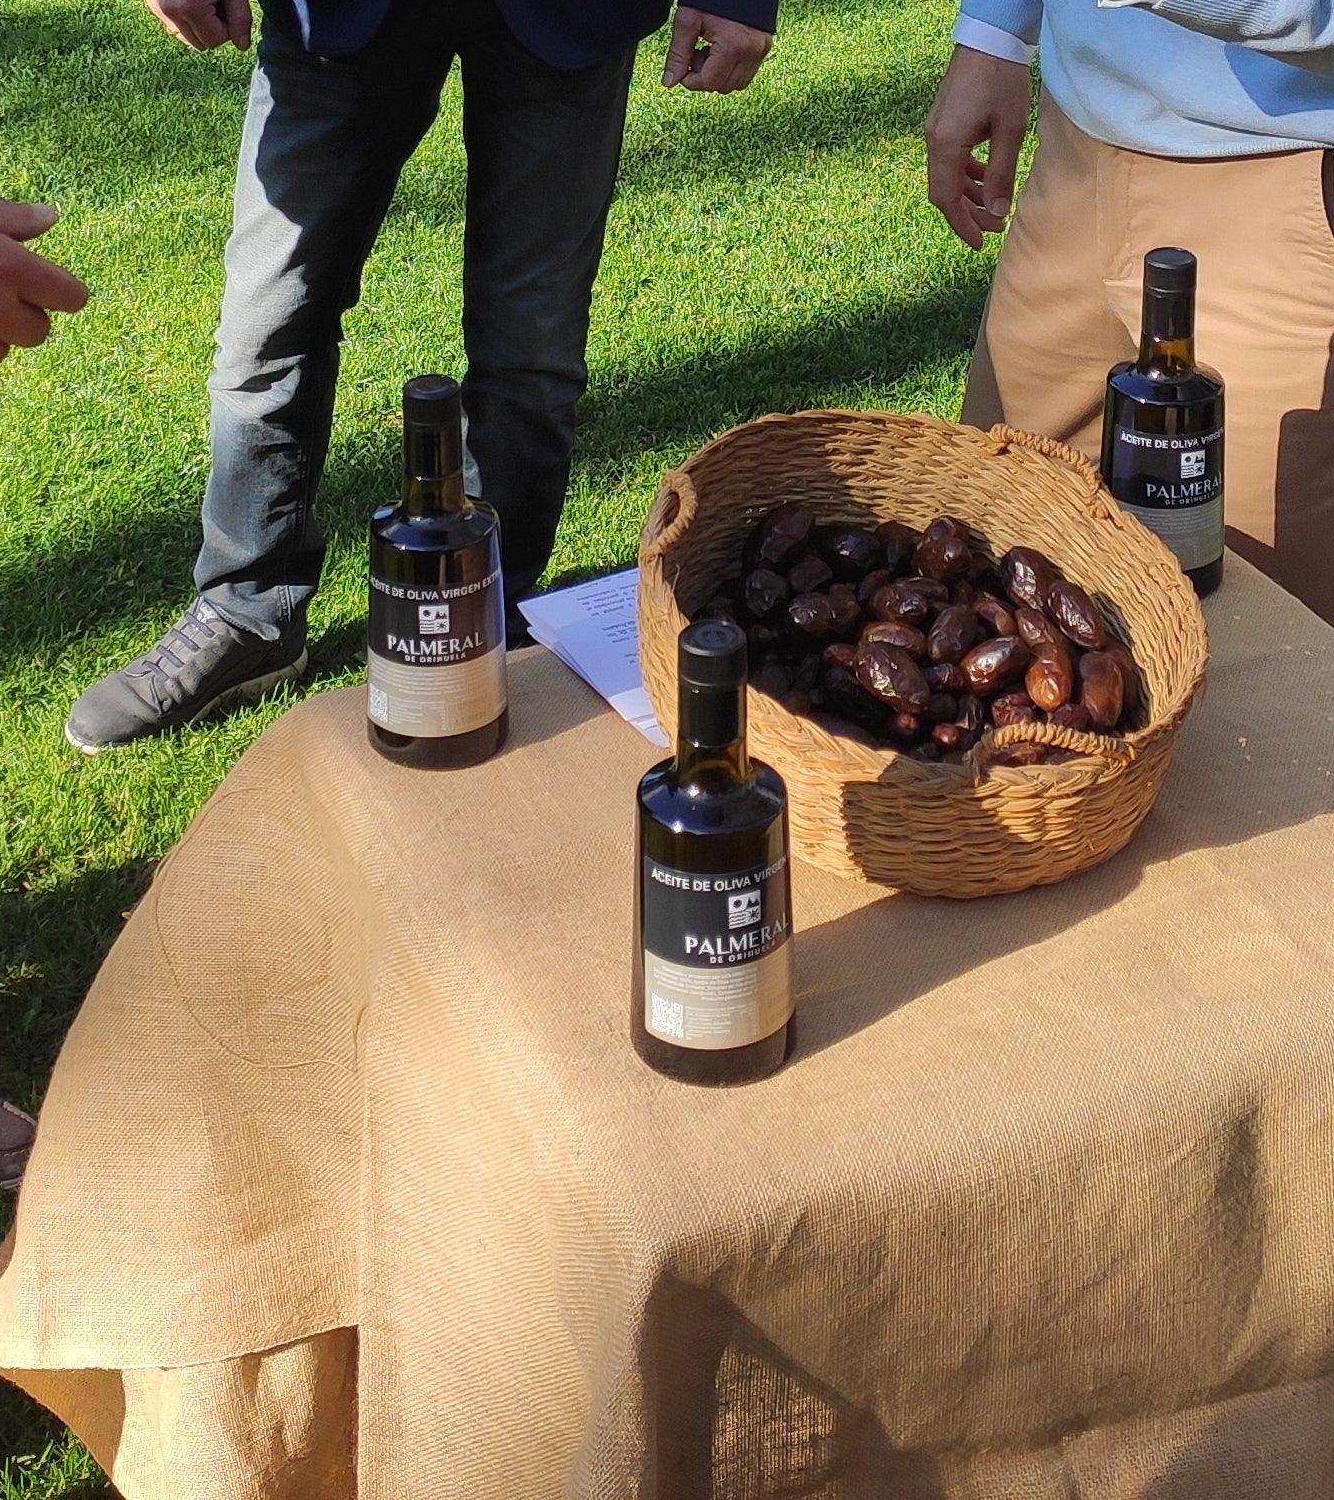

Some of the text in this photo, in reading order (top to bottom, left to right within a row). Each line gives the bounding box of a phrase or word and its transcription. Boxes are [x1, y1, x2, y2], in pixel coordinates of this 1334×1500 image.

[1154, 440, 1169, 449] DE
[1170, 438, 1199, 449] OLIVA
[392, 587, 405, 599] DE
[407, 590, 439, 601] OLIVA
[441, 583, 481, 600] VIRGEN
[387, 631, 484, 656] PALMERAL
[404, 654, 416, 662] DE
[651, 867, 690, 890] ACEITE
[692, 880, 711, 891] DE
[714, 876, 751, 892] OLIVA
[685, 912, 789, 956] PALMERAL
[709, 956, 724, 964] DE
